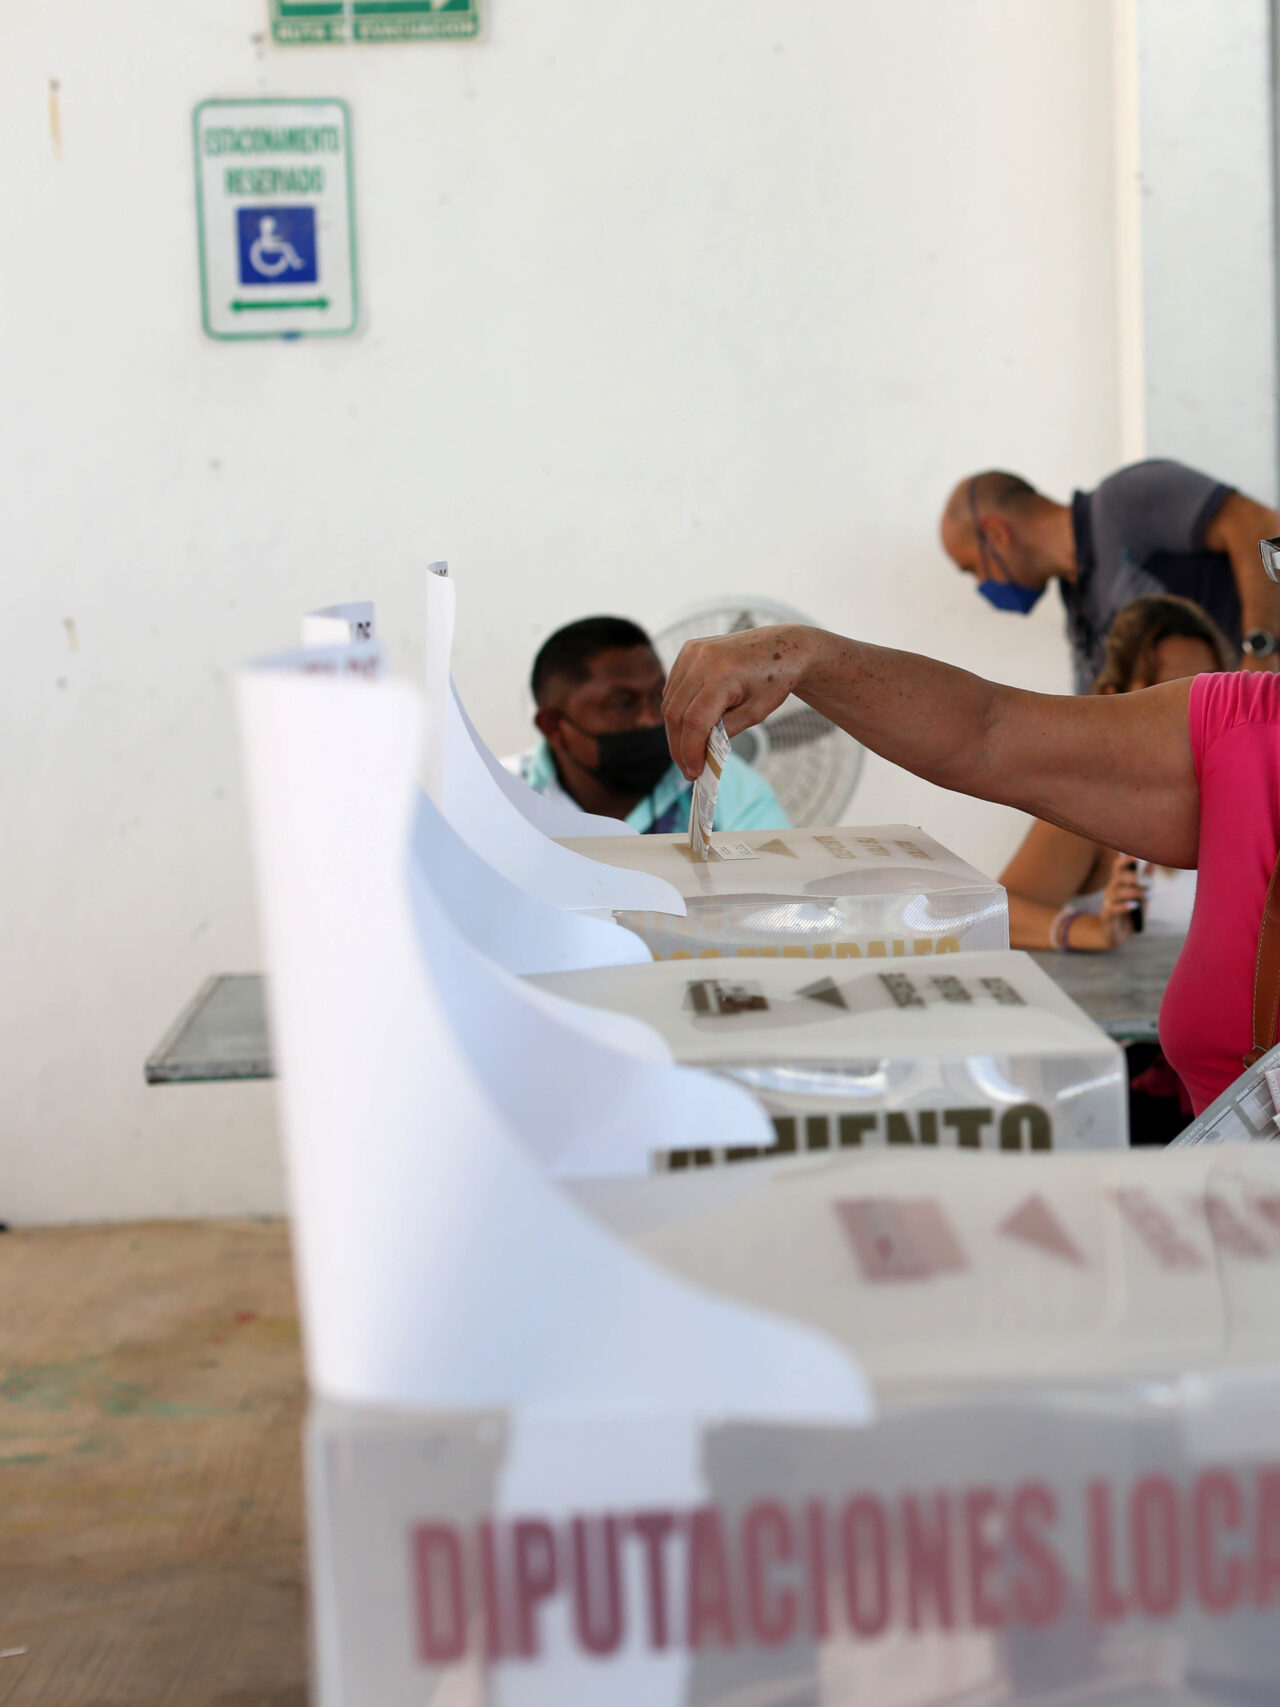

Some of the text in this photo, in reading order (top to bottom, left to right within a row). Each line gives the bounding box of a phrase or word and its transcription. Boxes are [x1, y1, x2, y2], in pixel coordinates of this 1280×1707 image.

[205, 126, 338, 155] ESTACIONAMIENTO
[225, 166, 323, 195] RESERVADO
[410, 1484, 1064, 1668] DIPUTACIONES
